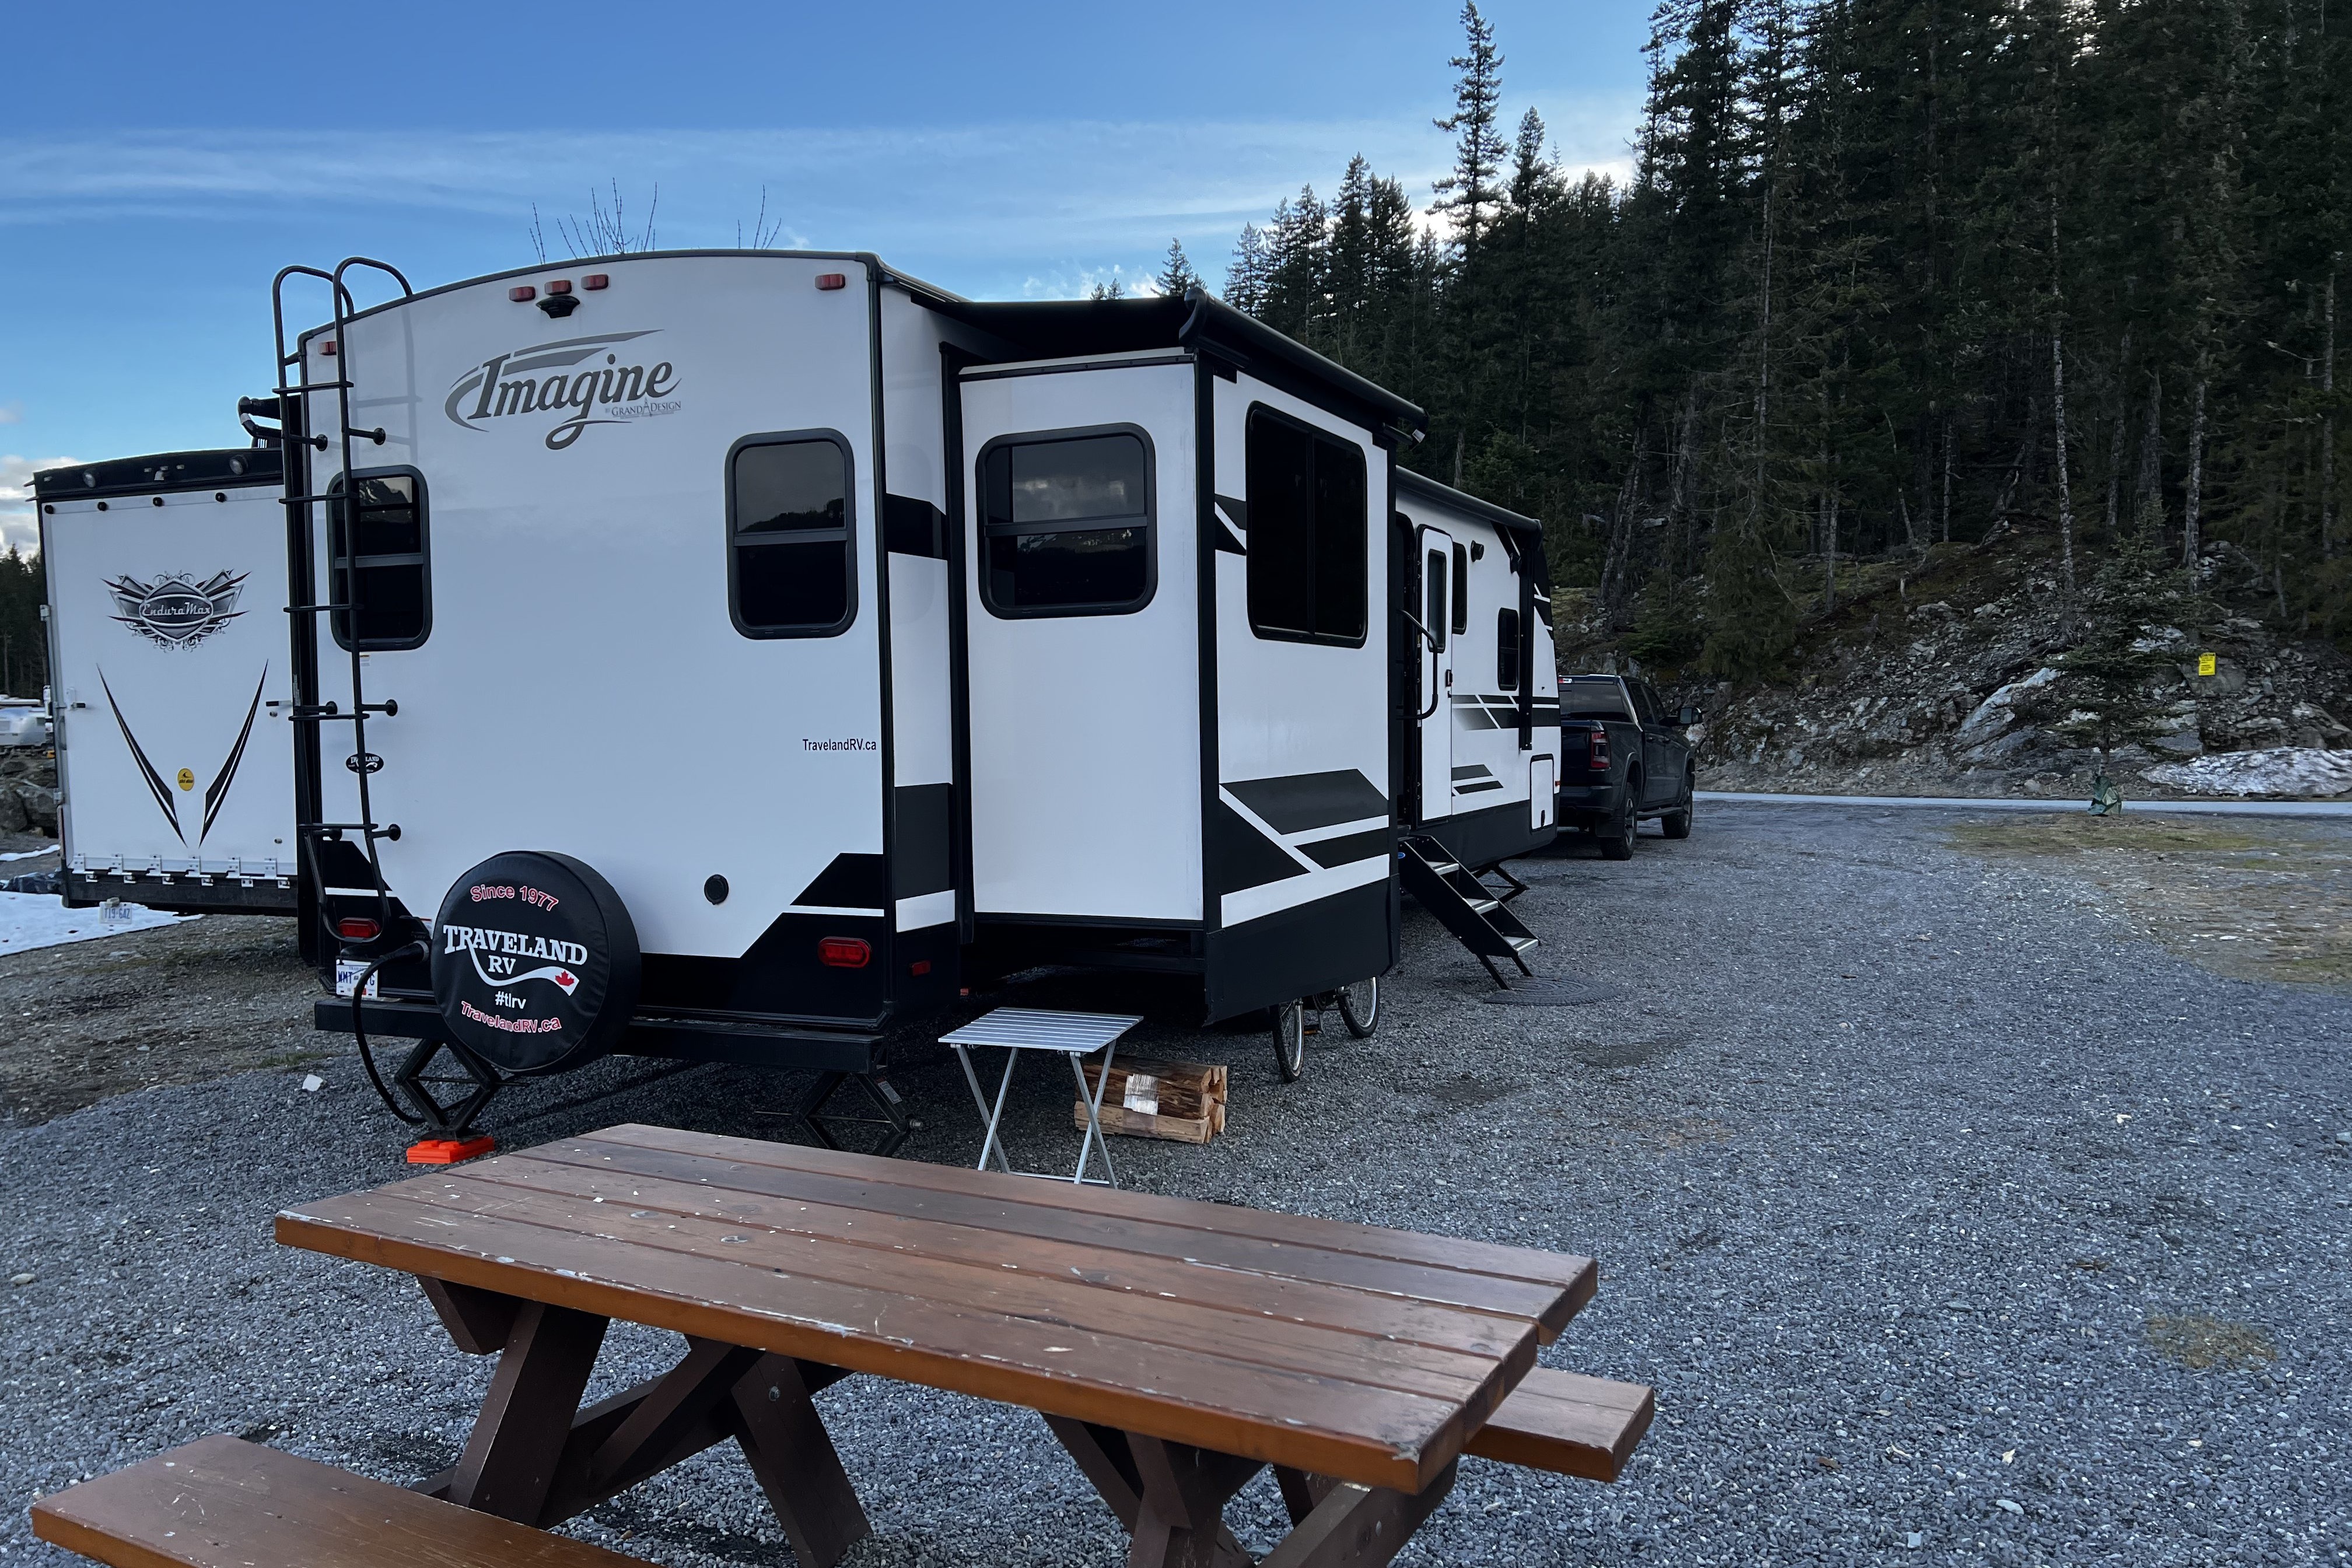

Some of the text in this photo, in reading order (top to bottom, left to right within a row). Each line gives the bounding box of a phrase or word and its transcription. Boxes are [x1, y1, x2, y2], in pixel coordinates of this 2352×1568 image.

[467, 352, 682, 450] Imagine
[142, 602, 211, 616] EnduraMax
[803, 738, 876, 750] TravelandRV.ca
[470, 884, 559, 911] Since 1977
[443, 925, 587, 965] TRAVELAND
[488, 955, 516, 975] RV
[495, 991, 526, 1009] #tlrv
[461, 1001, 562, 1032] TravelandRV.ca
